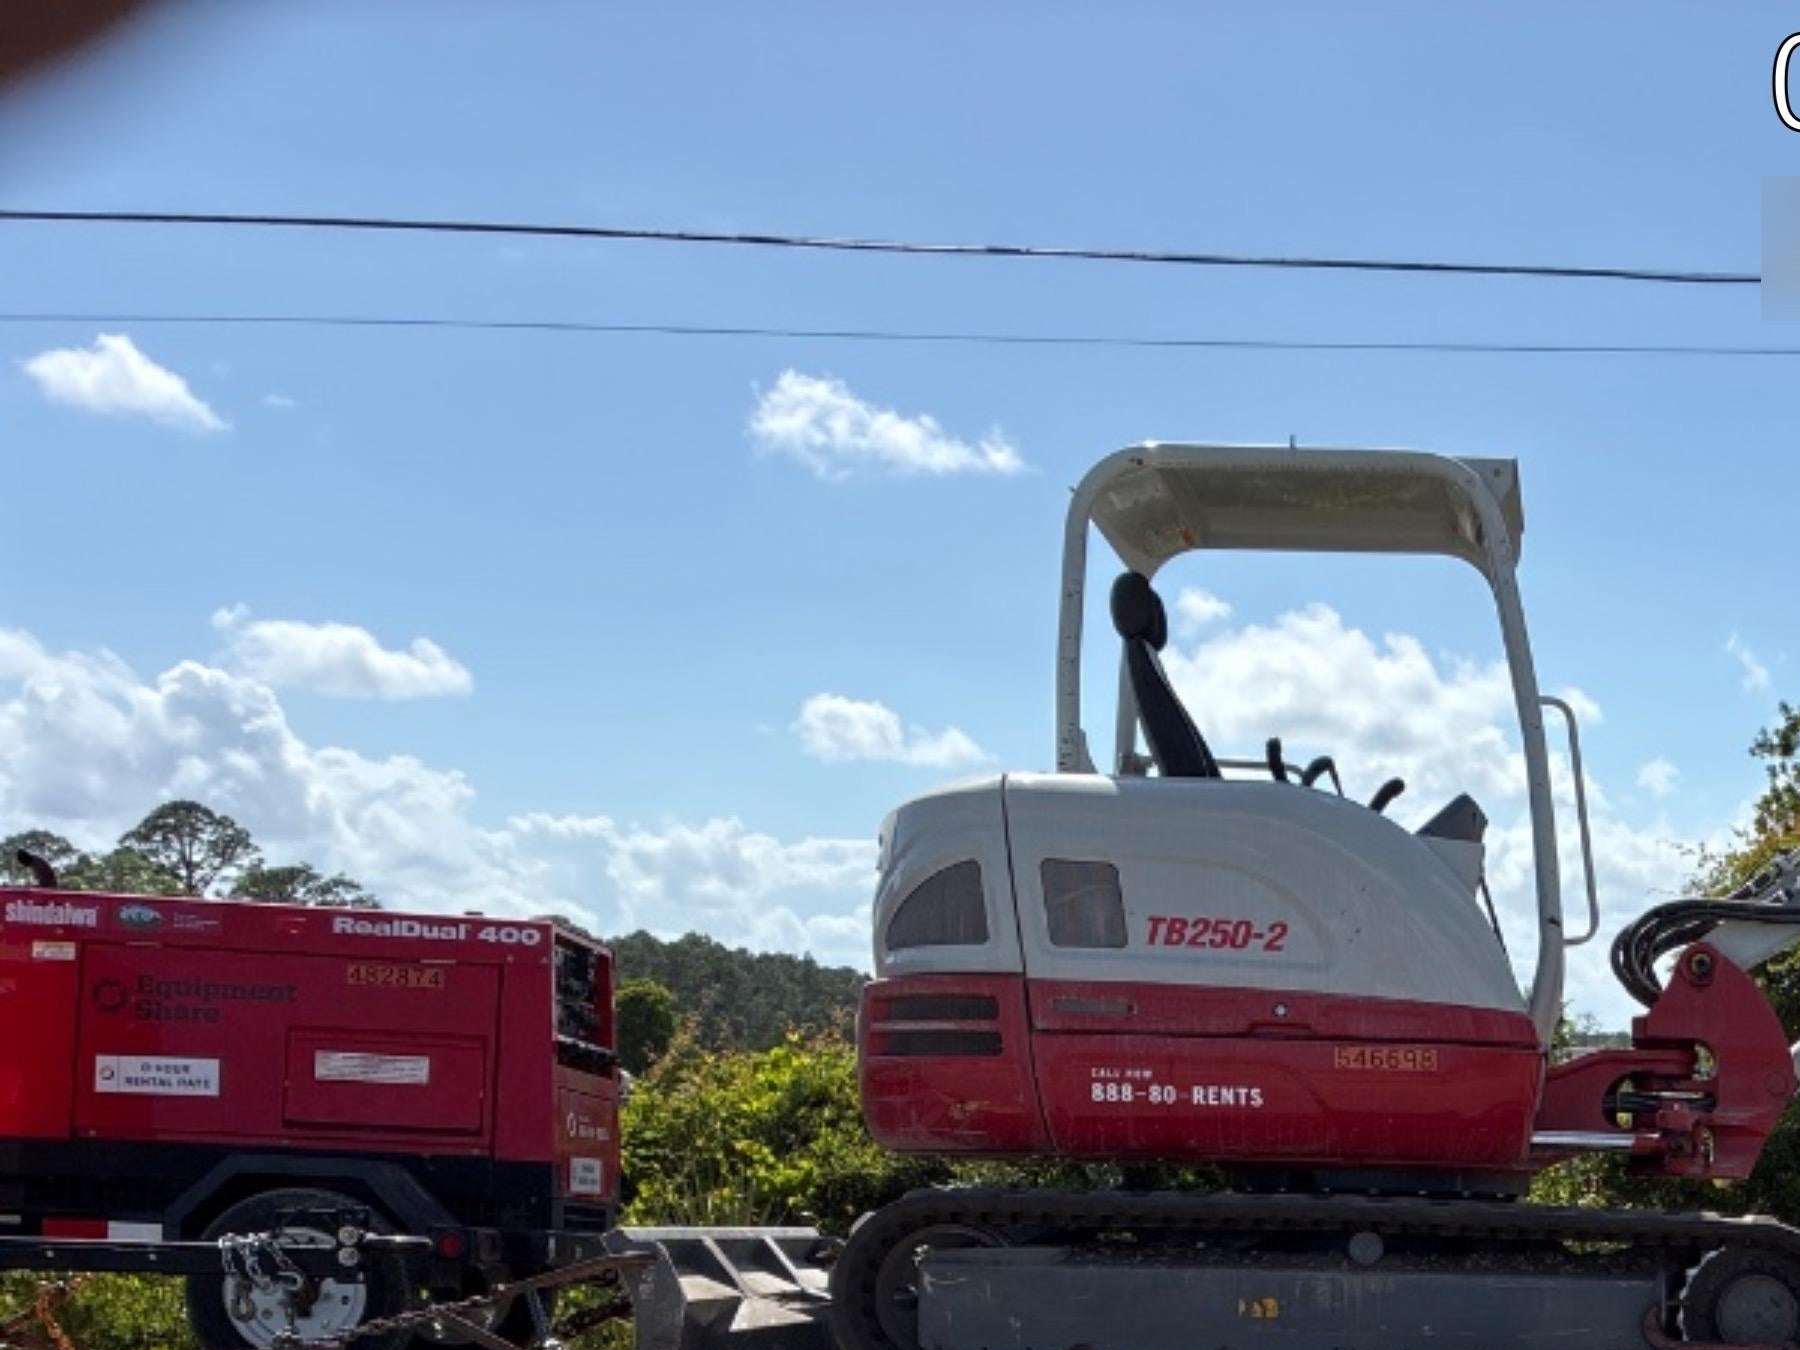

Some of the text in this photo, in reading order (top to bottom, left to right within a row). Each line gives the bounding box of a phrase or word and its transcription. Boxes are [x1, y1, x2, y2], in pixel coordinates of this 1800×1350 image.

[333, 916, 541, 945] RealDual 400
[1147, 915, 1290, 952] TB250-2
[137, 974, 298, 1003] Equipment
[135, 1001, 220, 1023] Share
